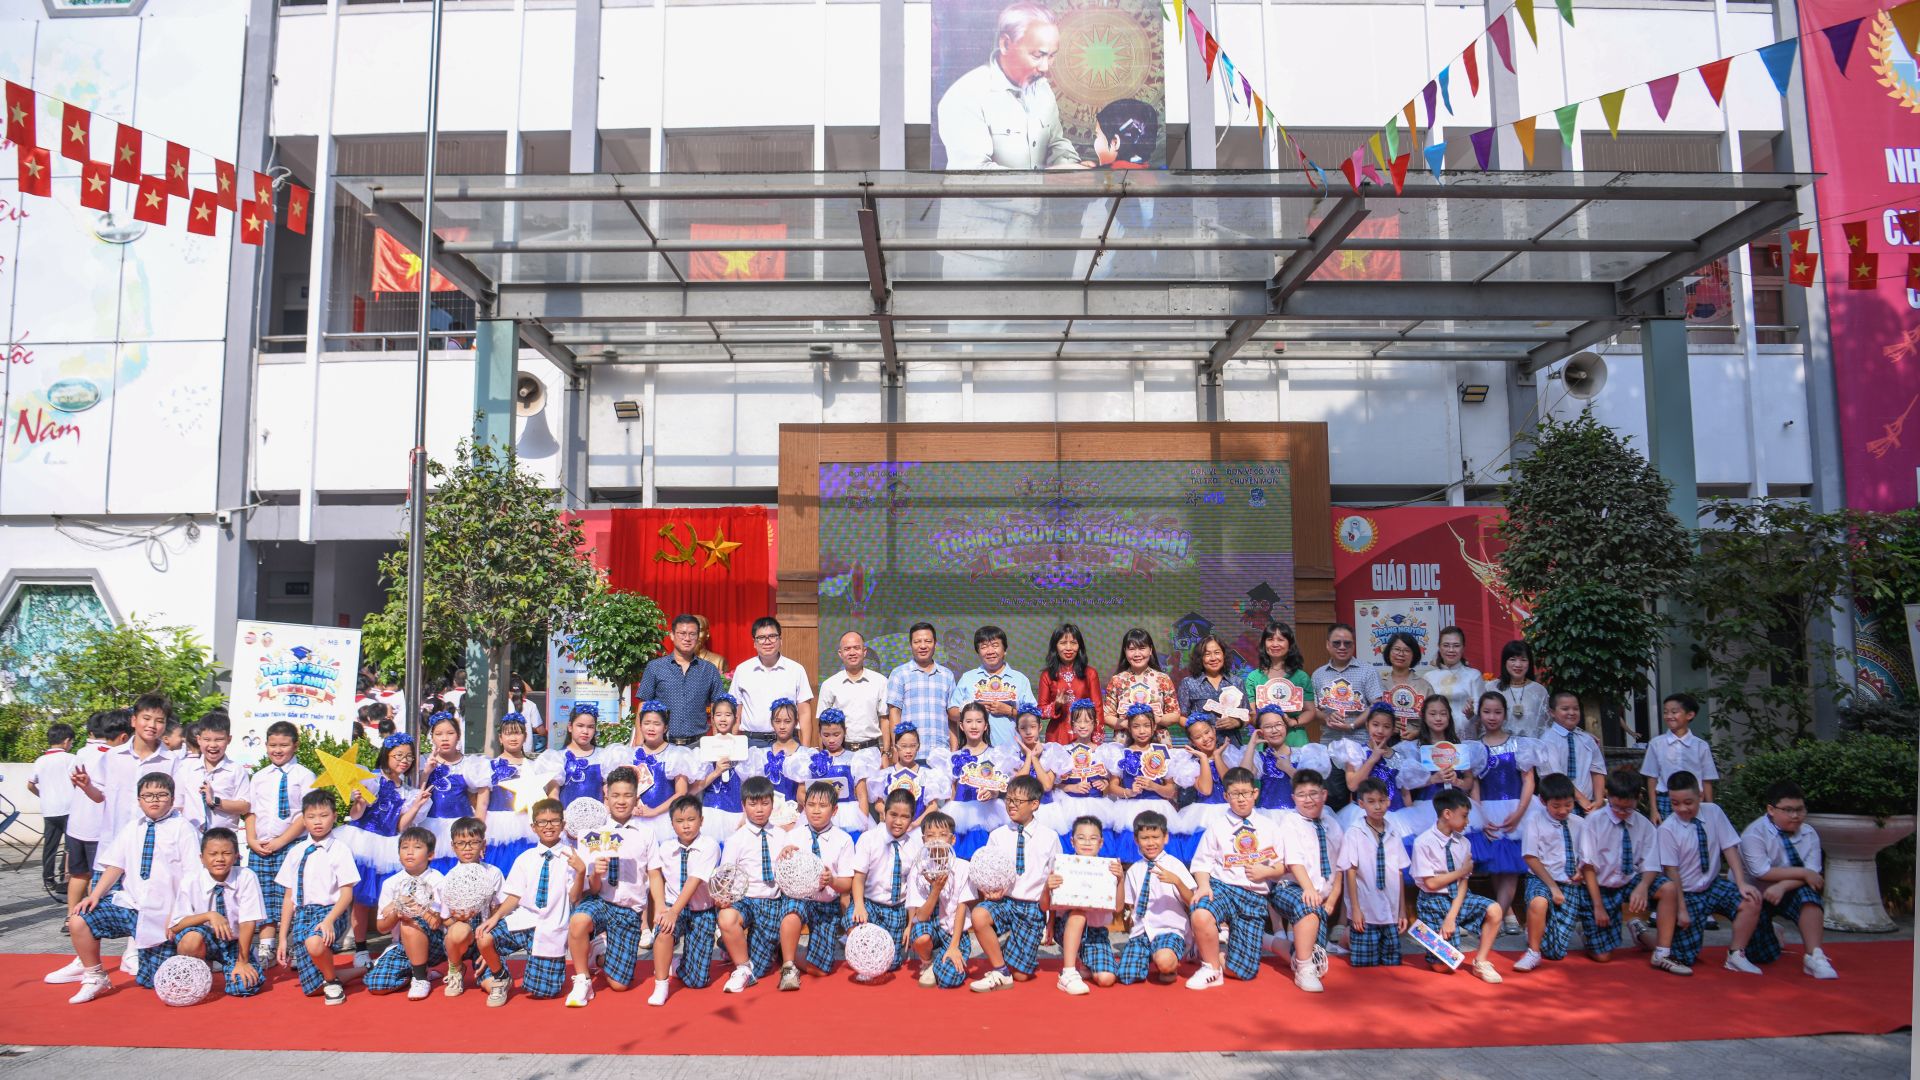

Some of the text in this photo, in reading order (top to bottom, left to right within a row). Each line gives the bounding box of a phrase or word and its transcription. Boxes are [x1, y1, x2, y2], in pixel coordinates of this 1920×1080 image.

[13, 407, 81, 447] Nam
[1371, 558, 1441, 597] GIÁO DỤC
